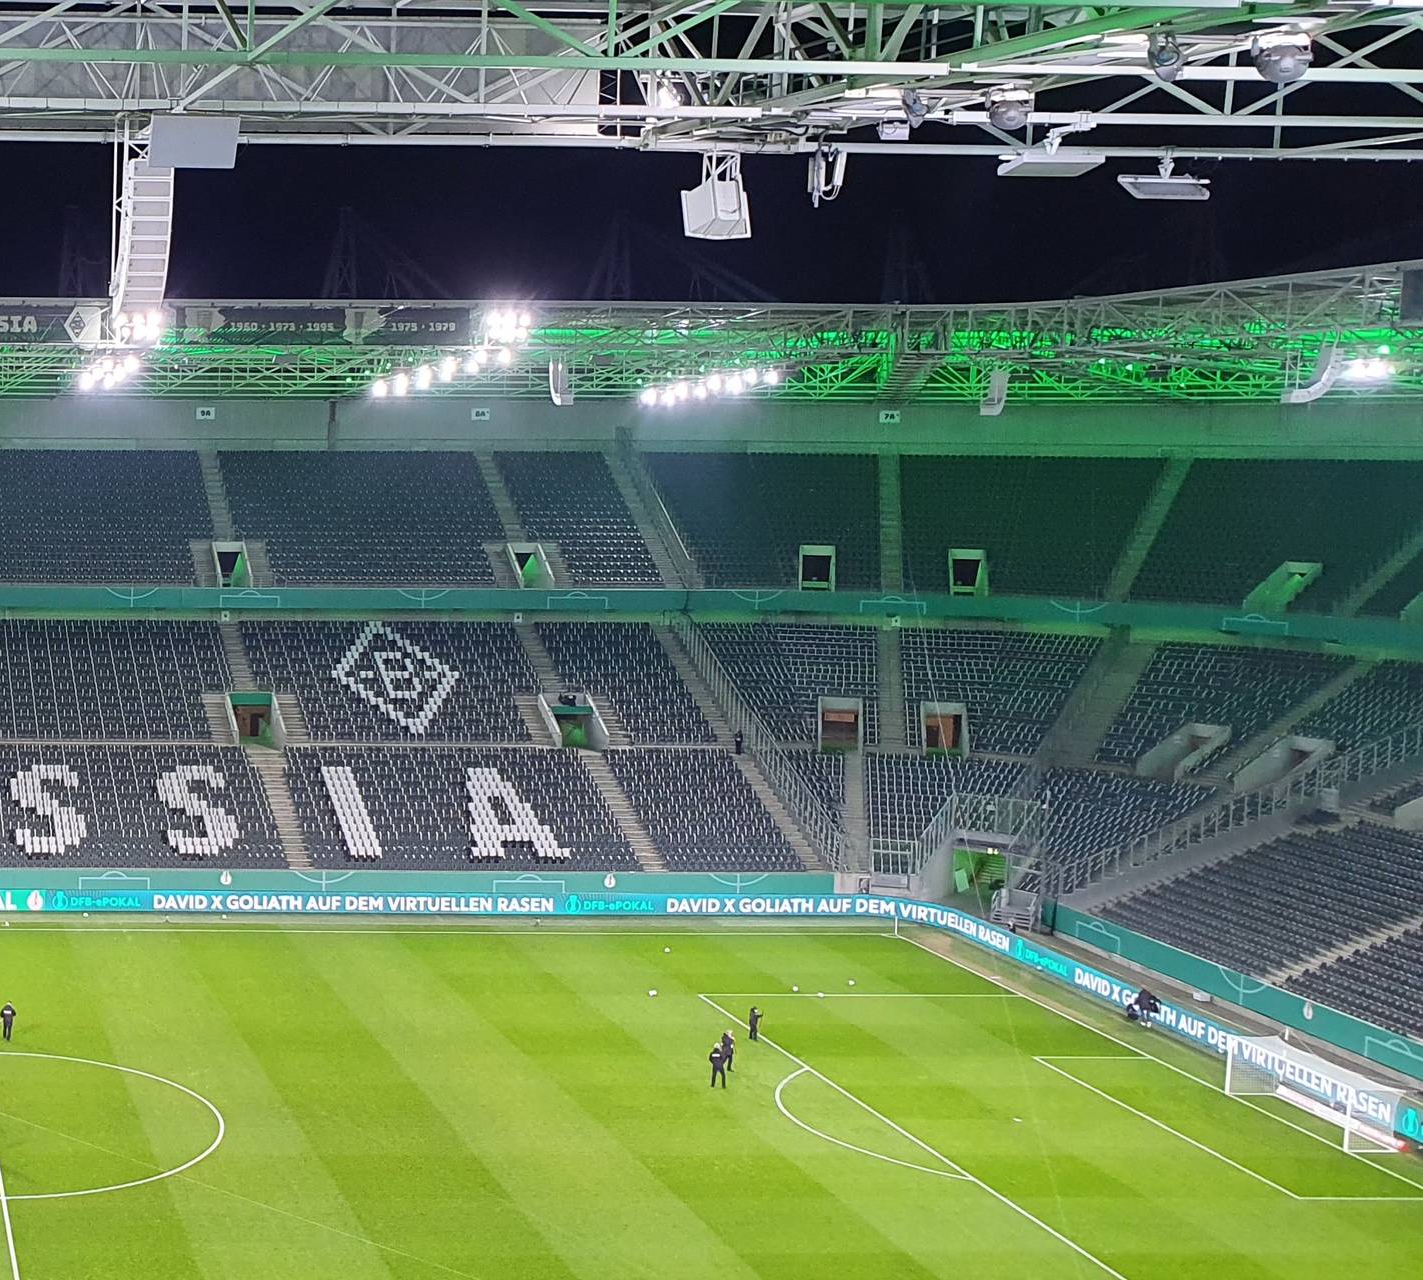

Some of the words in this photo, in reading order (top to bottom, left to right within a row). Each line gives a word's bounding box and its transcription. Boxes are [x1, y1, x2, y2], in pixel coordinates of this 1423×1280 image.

[230, 322, 258, 332] 1960
[269, 322, 296, 332] 1973
[306, 322, 334, 332] 1995
[391, 322, 418, 332] 1975
[70, 896, 141, 907] DFB-ePOKAL
[153, 895, 208, 910] DAVID
[210, 895, 223, 910] X
[226, 895, 303, 911] GOLIATH
[306, 896, 341, 911] AUF
[345, 896, 384, 911] DEM
[387, 896, 493, 912] VIRTUELLEN
[497, 897, 554, 912] RASEN
[582, 900, 655, 912] DFB-ePOKAL
[666, 898, 721, 913] DAVID
[723, 899, 736, 913] X
[739, 898, 814, 914] GOLIATH
[817, 898, 852, 914] AUF
[855, 899, 897, 916] DEM
[898, 903, 977, 937] VIRTUELLEN
[978, 924, 1010, 952] RASEN
[1074, 968, 1111, 1001] DAVID
[1111, 984, 1121, 1006] X
[1178, 1013, 1206, 1039] AUF
[1207, 1026, 1238, 1056] DEM
[1241, 1041, 1332, 1097] VIRTUELLEN
[1337, 1083, 1392, 1124] RASEN
